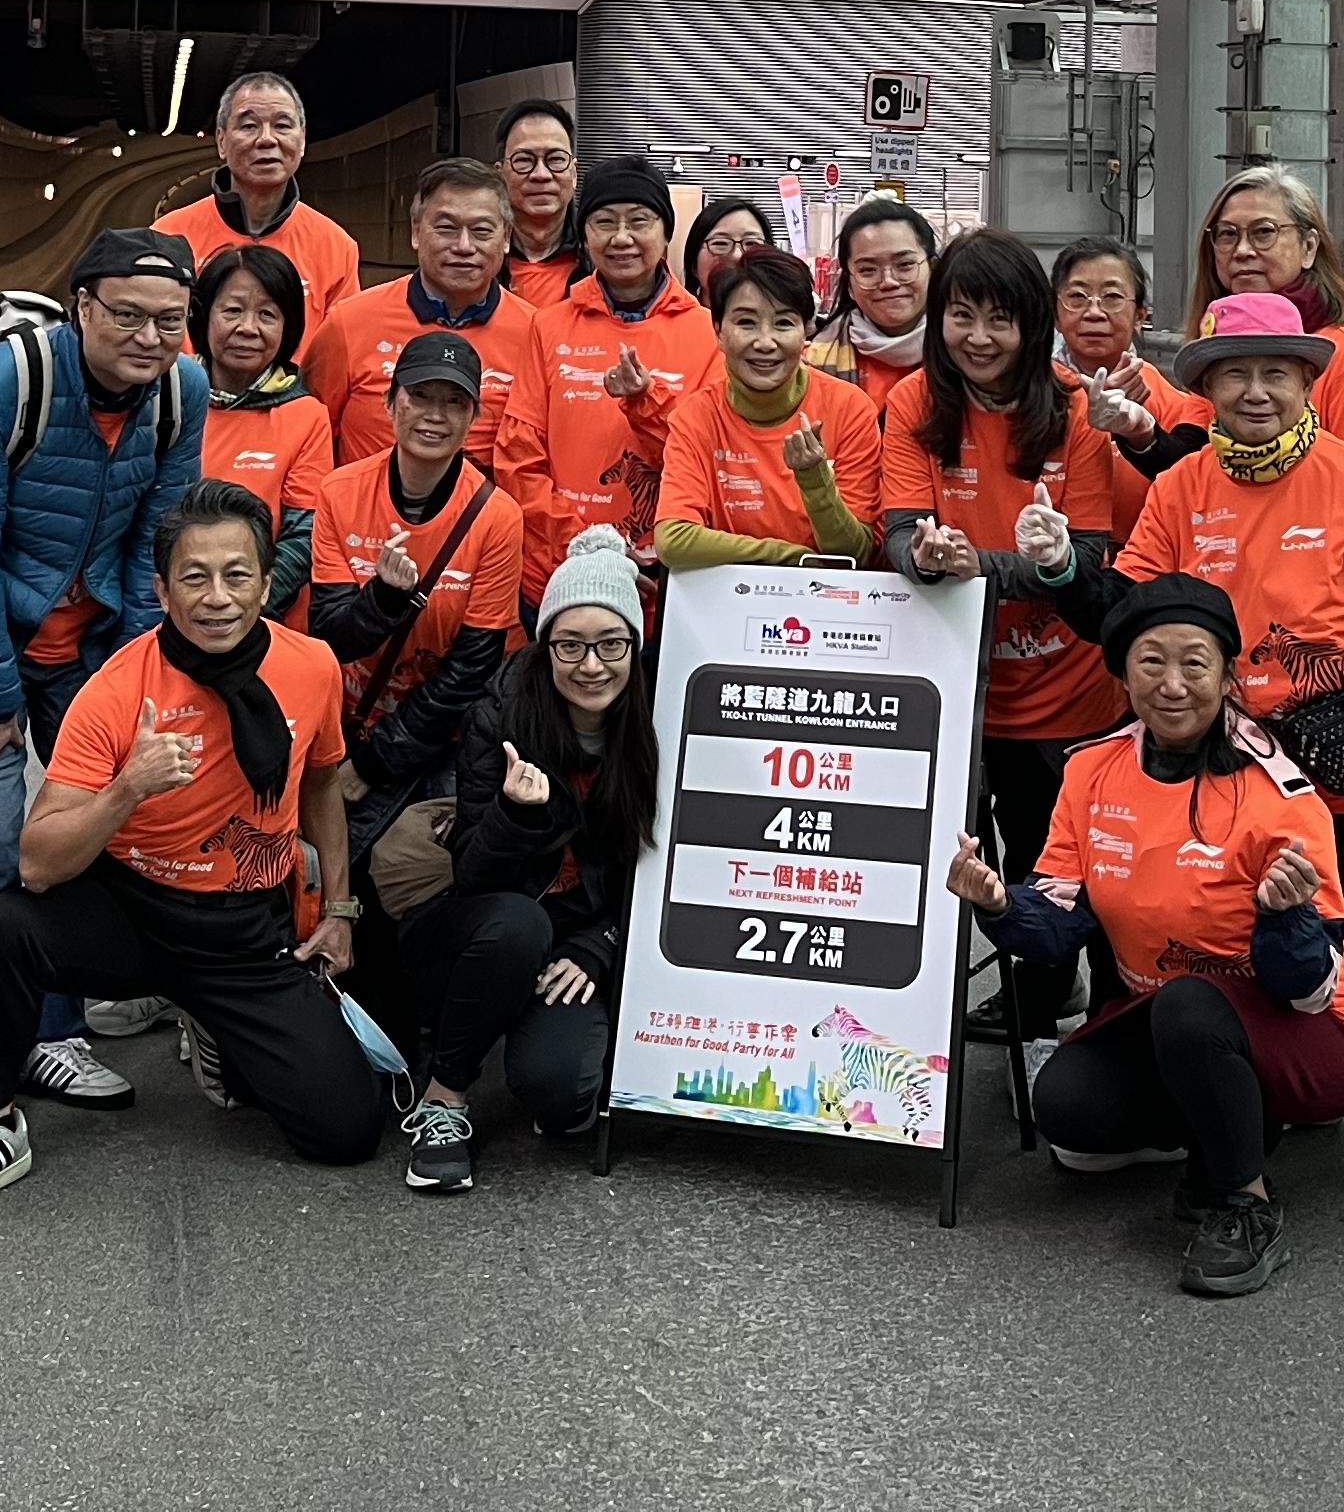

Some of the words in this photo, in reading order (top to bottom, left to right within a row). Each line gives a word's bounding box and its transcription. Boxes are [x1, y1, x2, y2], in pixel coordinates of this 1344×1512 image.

[1246, 672, 1269, 686] Good
[720, 683, 900, 717] 將藍隧道九龍入口
[756, 712, 793, 724] TUNNEL
[794, 716, 844, 728] KOWLOON
[845, 718, 898, 732] ENTRANCE
[763, 746, 815, 789] 10
[819, 751, 853, 771] 公里
[818, 772, 851, 792] KM
[763, 806, 794, 849] 4
[798, 810, 833, 831] 公里
[797, 831, 831, 852] KM
[187, 861, 215, 872] Good
[1175, 856, 1226, 870] LI-NING
[728, 860, 863, 895] 下一個補給站
[728, 888, 754, 898] NEXT
[755, 890, 826, 906] REFRESHMENT
[828, 897, 858, 908] POINT
[735, 916, 808, 964] 2.7
[810, 925, 845, 947] 公里
[808, 947, 843, 969] KM
[634, 1029, 683, 1047] Marathon
[684, 1035, 702, 1049] for
[732, 1041, 762, 1059] Party
[762, 1044, 781, 1058] for
[779, 1047, 796, 1061] All
